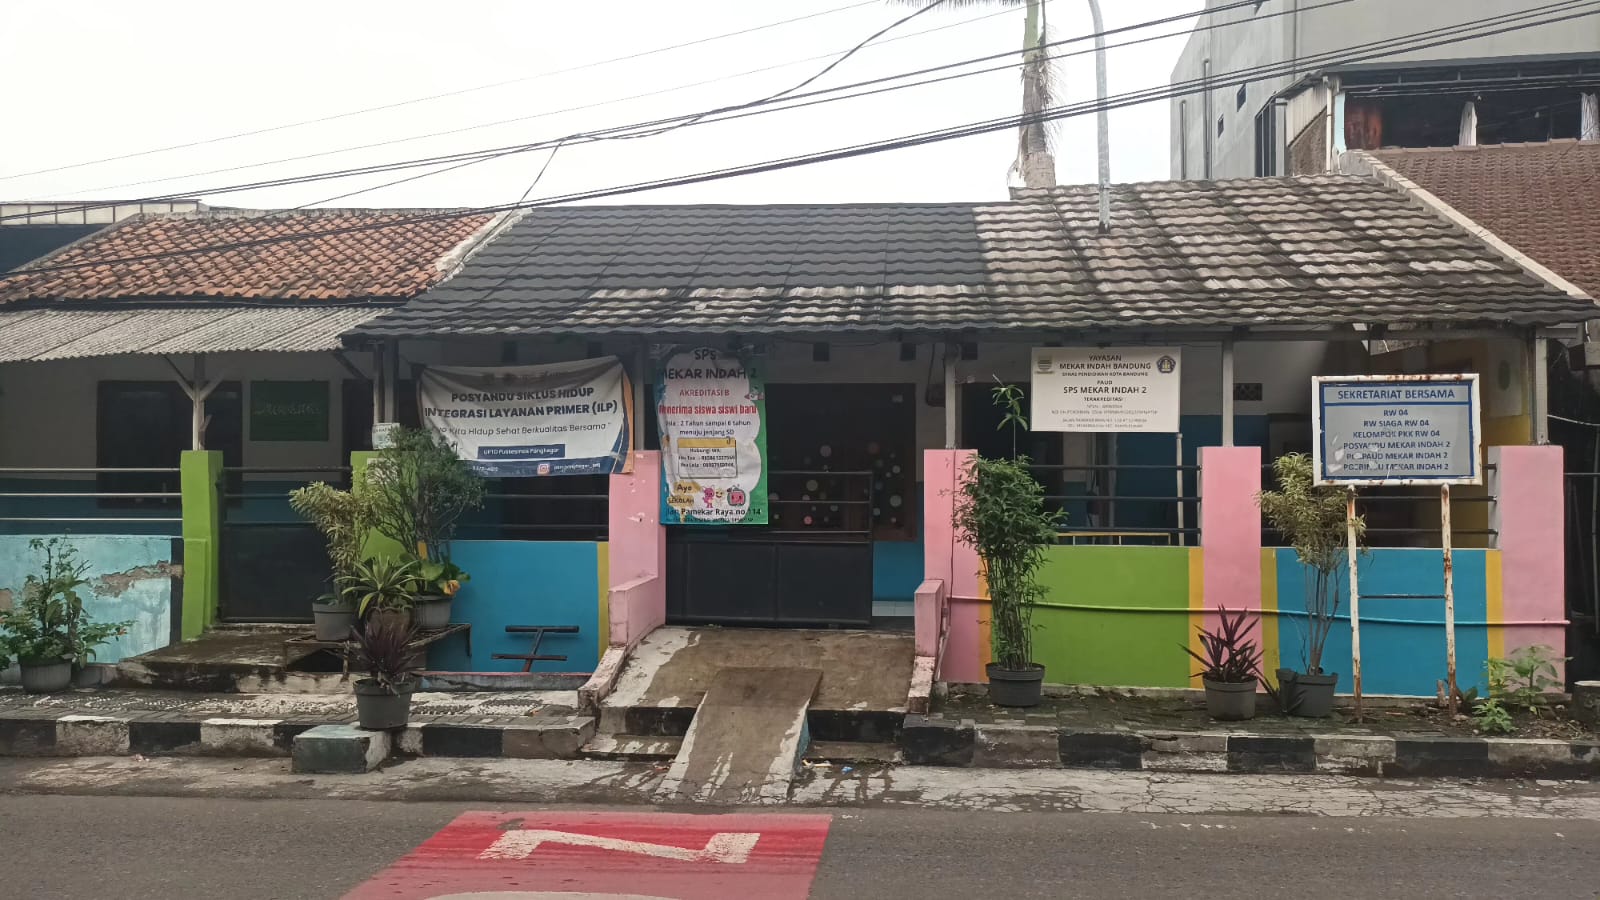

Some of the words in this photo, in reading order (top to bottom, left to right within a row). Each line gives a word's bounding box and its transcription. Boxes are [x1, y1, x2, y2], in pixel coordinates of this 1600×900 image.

[705, 367, 746, 380] INDAH
[749, 368, 757, 378] 2
[679, 388, 723, 397] AKREDITASI
[724, 388, 730, 397] B
[1063, 386, 1078, 394] SPS
[1080, 386, 1109, 394] MEKAR
[1111, 386, 1140, 394] INDAH
[1141, 386, 1147, 394] 2
[1338, 389, 1402, 399] SEKRETARIAT
[1405, 389, 1455, 399] BERSAMA
[451, 391, 515, 403] POSYANDU
[516, 389, 556, 401] SIKLUS
[557, 387, 595, 399] HIDUP
[424, 407, 488, 418] INTEGRASI
[489, 406, 545, 418] LAYANAN
[546, 404, 591, 416] PRIMER
[592, 400, 617, 415] (ILP)
[694, 404, 717, 414] siswa
[718, 404, 738, 414] siswi
[739, 404, 757, 414] baru
[1383, 409, 1397, 417] RW
[1398, 409, 1409, 417] 04
[705, 420, 727, 428] sampai
[1363, 420, 1377, 428] RW
[1378, 420, 1403, 428] SIAGA
[1419, 419, 1429, 427] 04
[468, 427, 494, 437] Hidup
[495, 427, 520, 436] Sehat
[521, 425, 568, 435] Berkualitas
[679, 430, 703, 438] menuju
[703, 430, 725, 438] jenjang
[1398, 430, 1414, 438] PKK
[1415, 430, 1428, 438] RW
[1430, 430, 1440, 438] 04
[1387, 441, 1416, 449] MEKAR
[1385, 452, 1413, 460] MEKAR
[676, 483, 692, 493] Ayo
[681, 508, 713, 516] Pamekar
[715, 508, 734, 517] Raya
